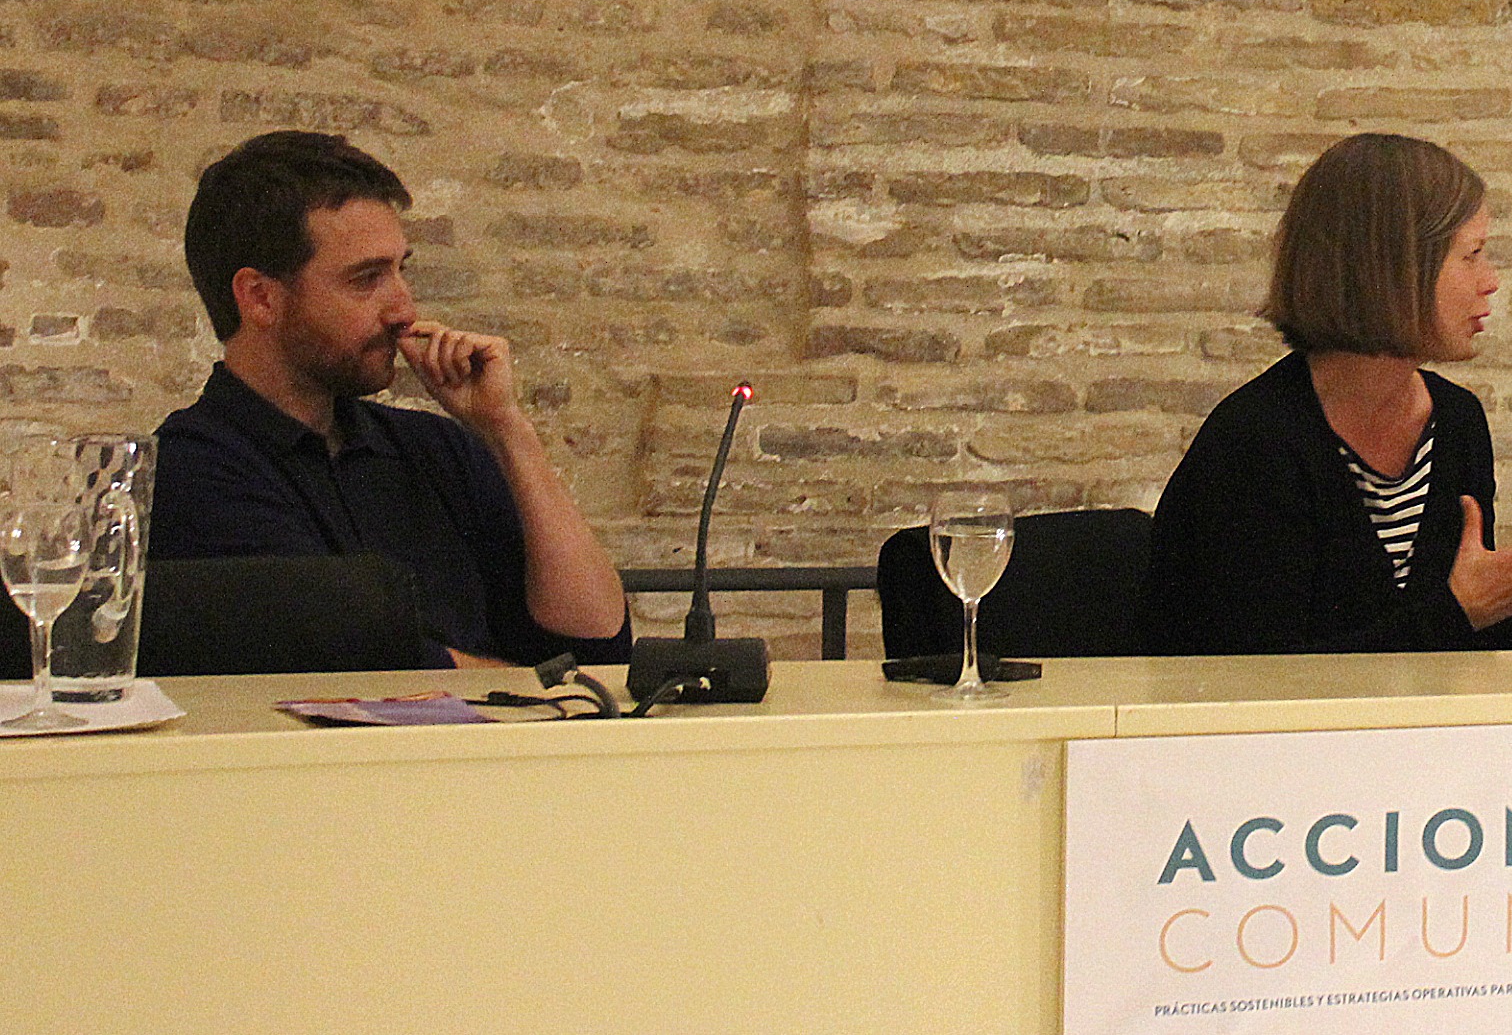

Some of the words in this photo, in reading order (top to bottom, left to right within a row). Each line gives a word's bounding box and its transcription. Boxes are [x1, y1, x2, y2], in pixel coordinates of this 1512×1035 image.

[1154, 1001, 1227, 1016] PRÁCTICAS
[1229, 996, 1315, 1012] SOSTENIBLES
[1316, 995, 1324, 1006] Y
[1327, 990, 1410, 1006] ESTRATEGIAS
[1411, 984, 1488, 1000] OPERATIVAS
